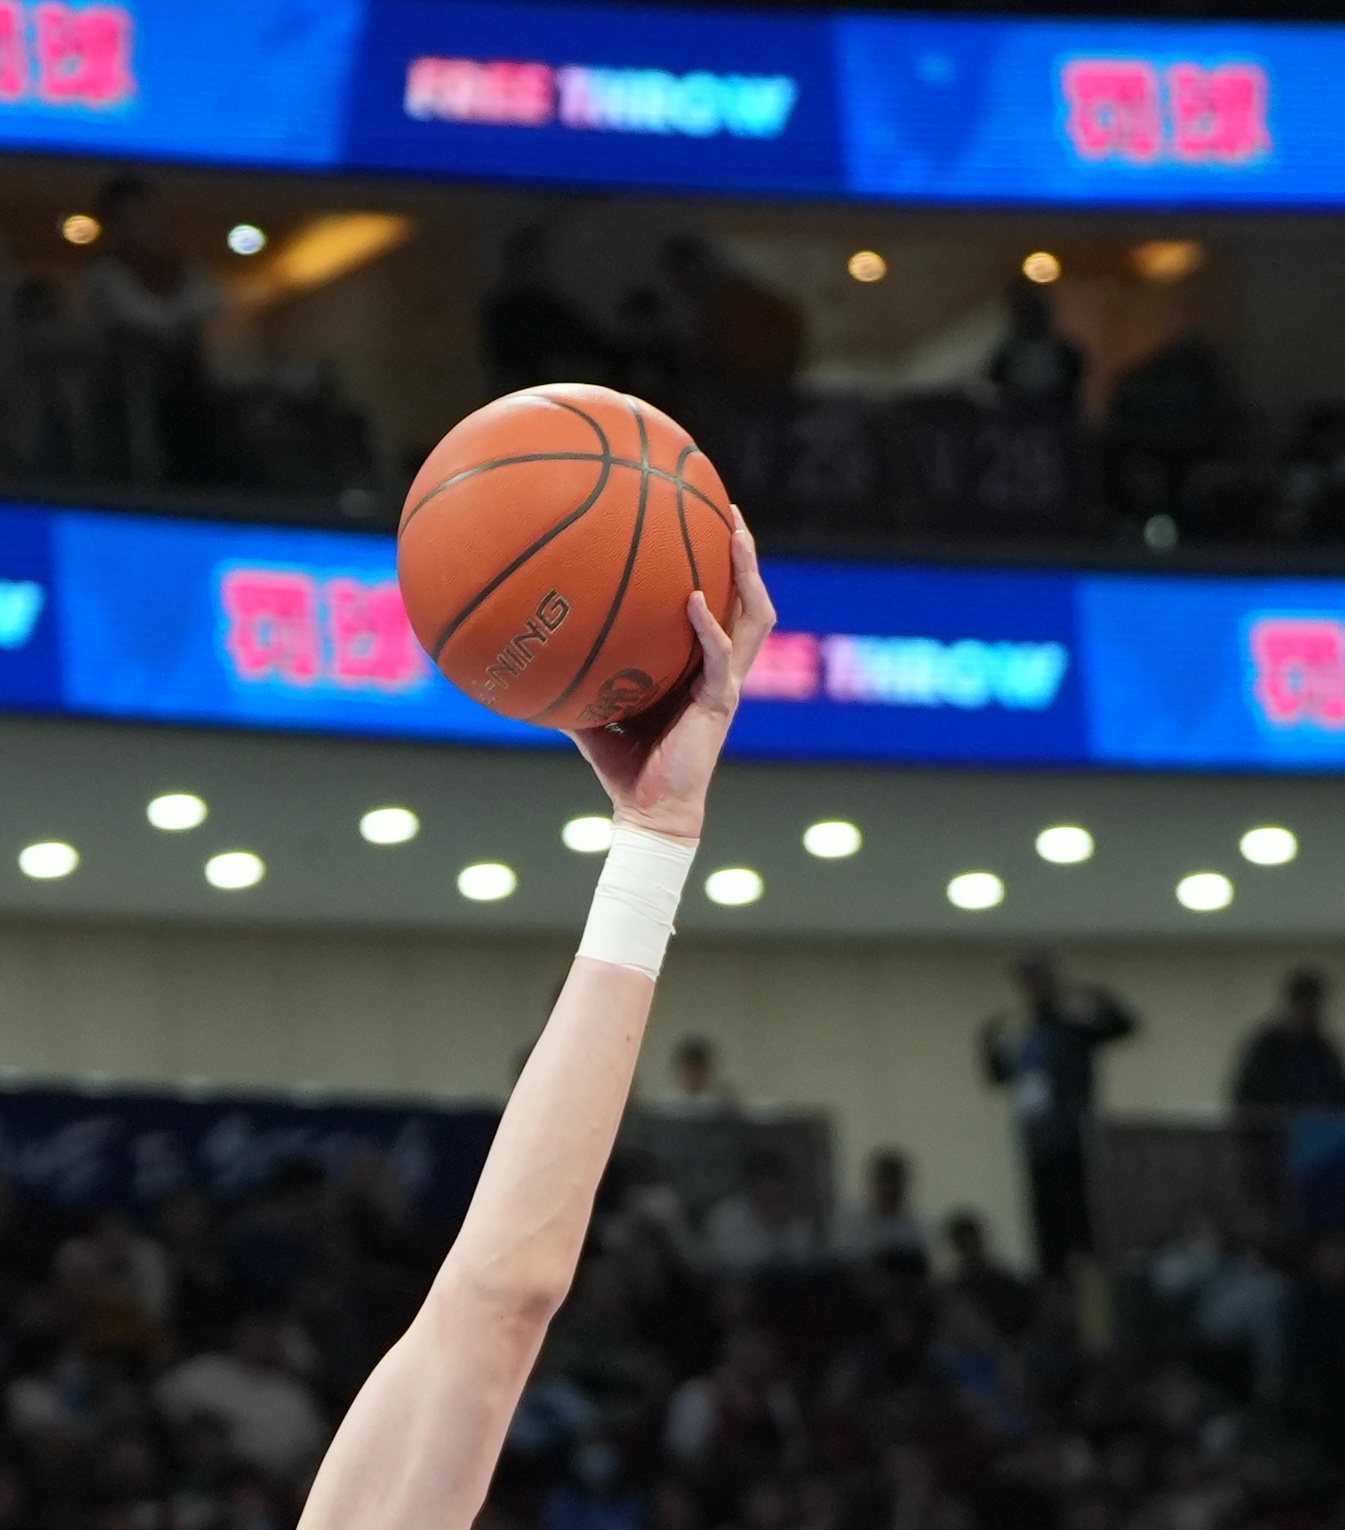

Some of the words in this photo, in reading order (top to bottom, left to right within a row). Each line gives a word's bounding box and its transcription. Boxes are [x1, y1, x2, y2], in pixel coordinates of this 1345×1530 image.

[405, 57, 554, 128] FREE
[555, 66, 797, 138] THROW
[822, 634, 1069, 711] THROW
